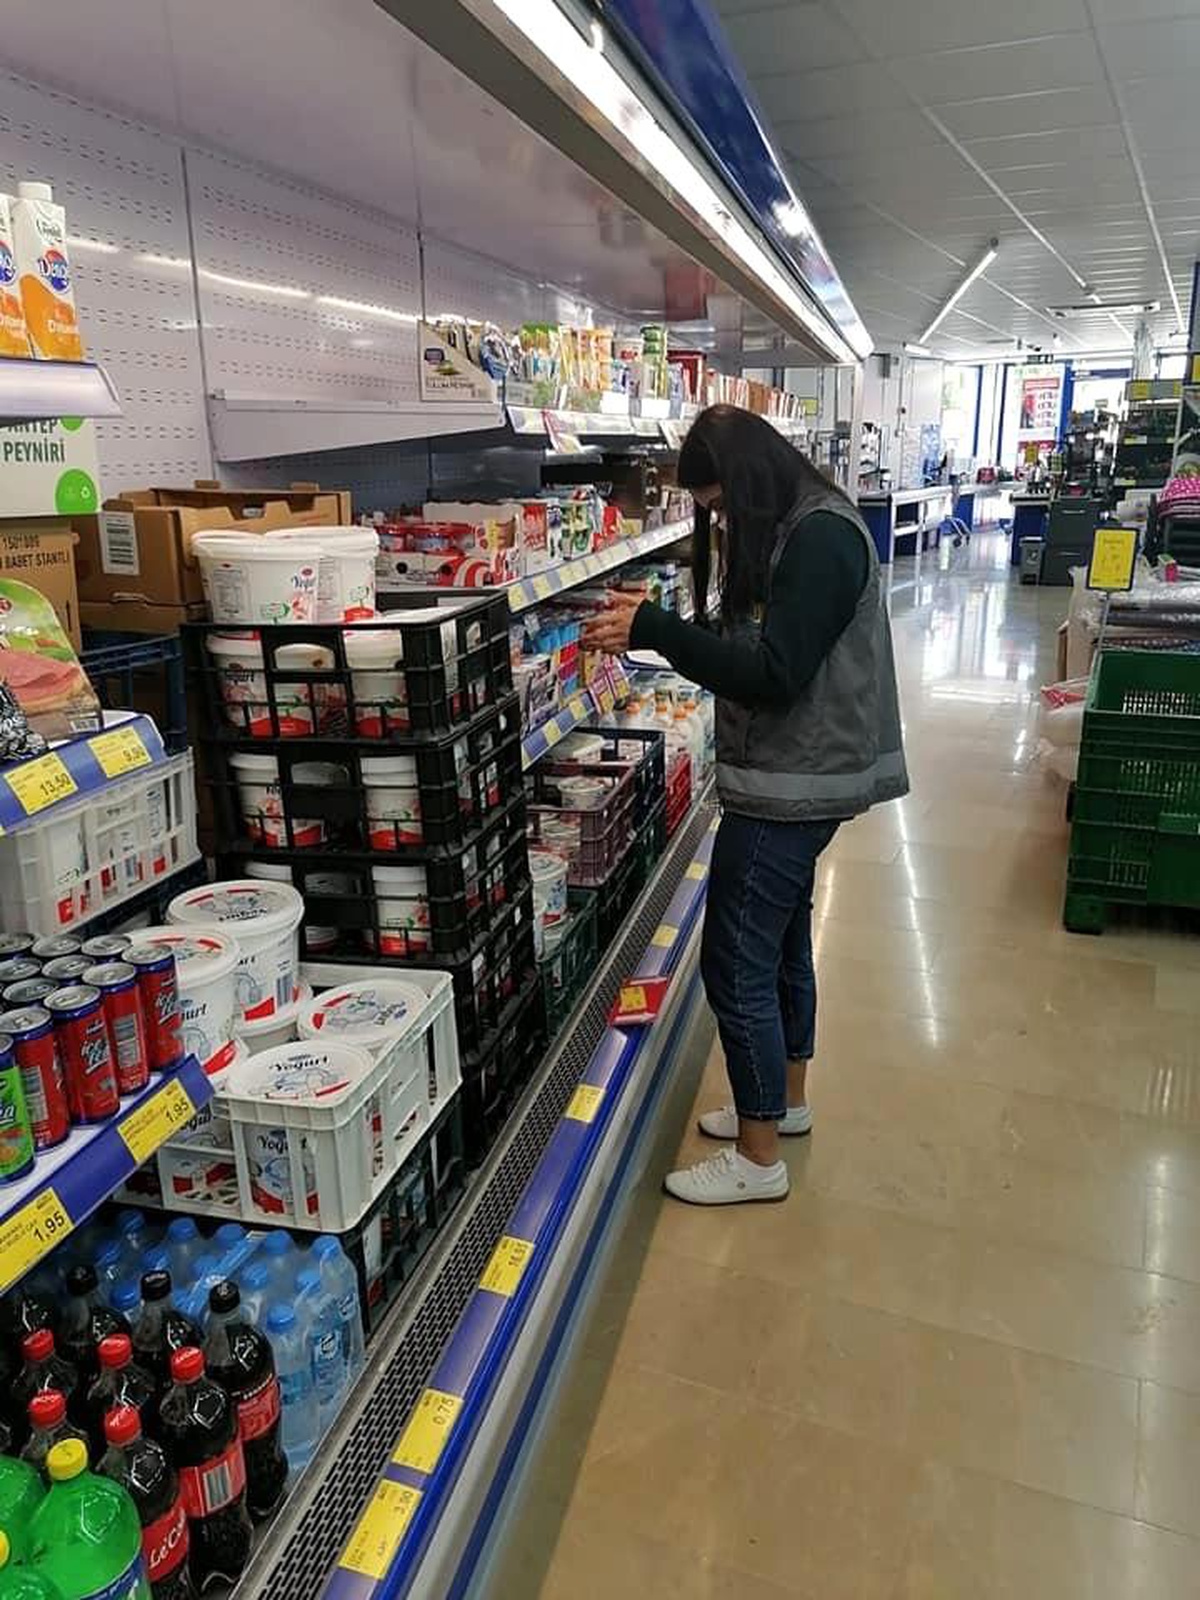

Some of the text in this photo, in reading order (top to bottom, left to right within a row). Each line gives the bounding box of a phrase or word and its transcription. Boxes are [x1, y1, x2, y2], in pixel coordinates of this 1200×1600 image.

[4, 438, 65, 462] PEYNİRİ
[164, 1096, 189, 1124] 1,95
[33, 1209, 65, 1243] 1,95
